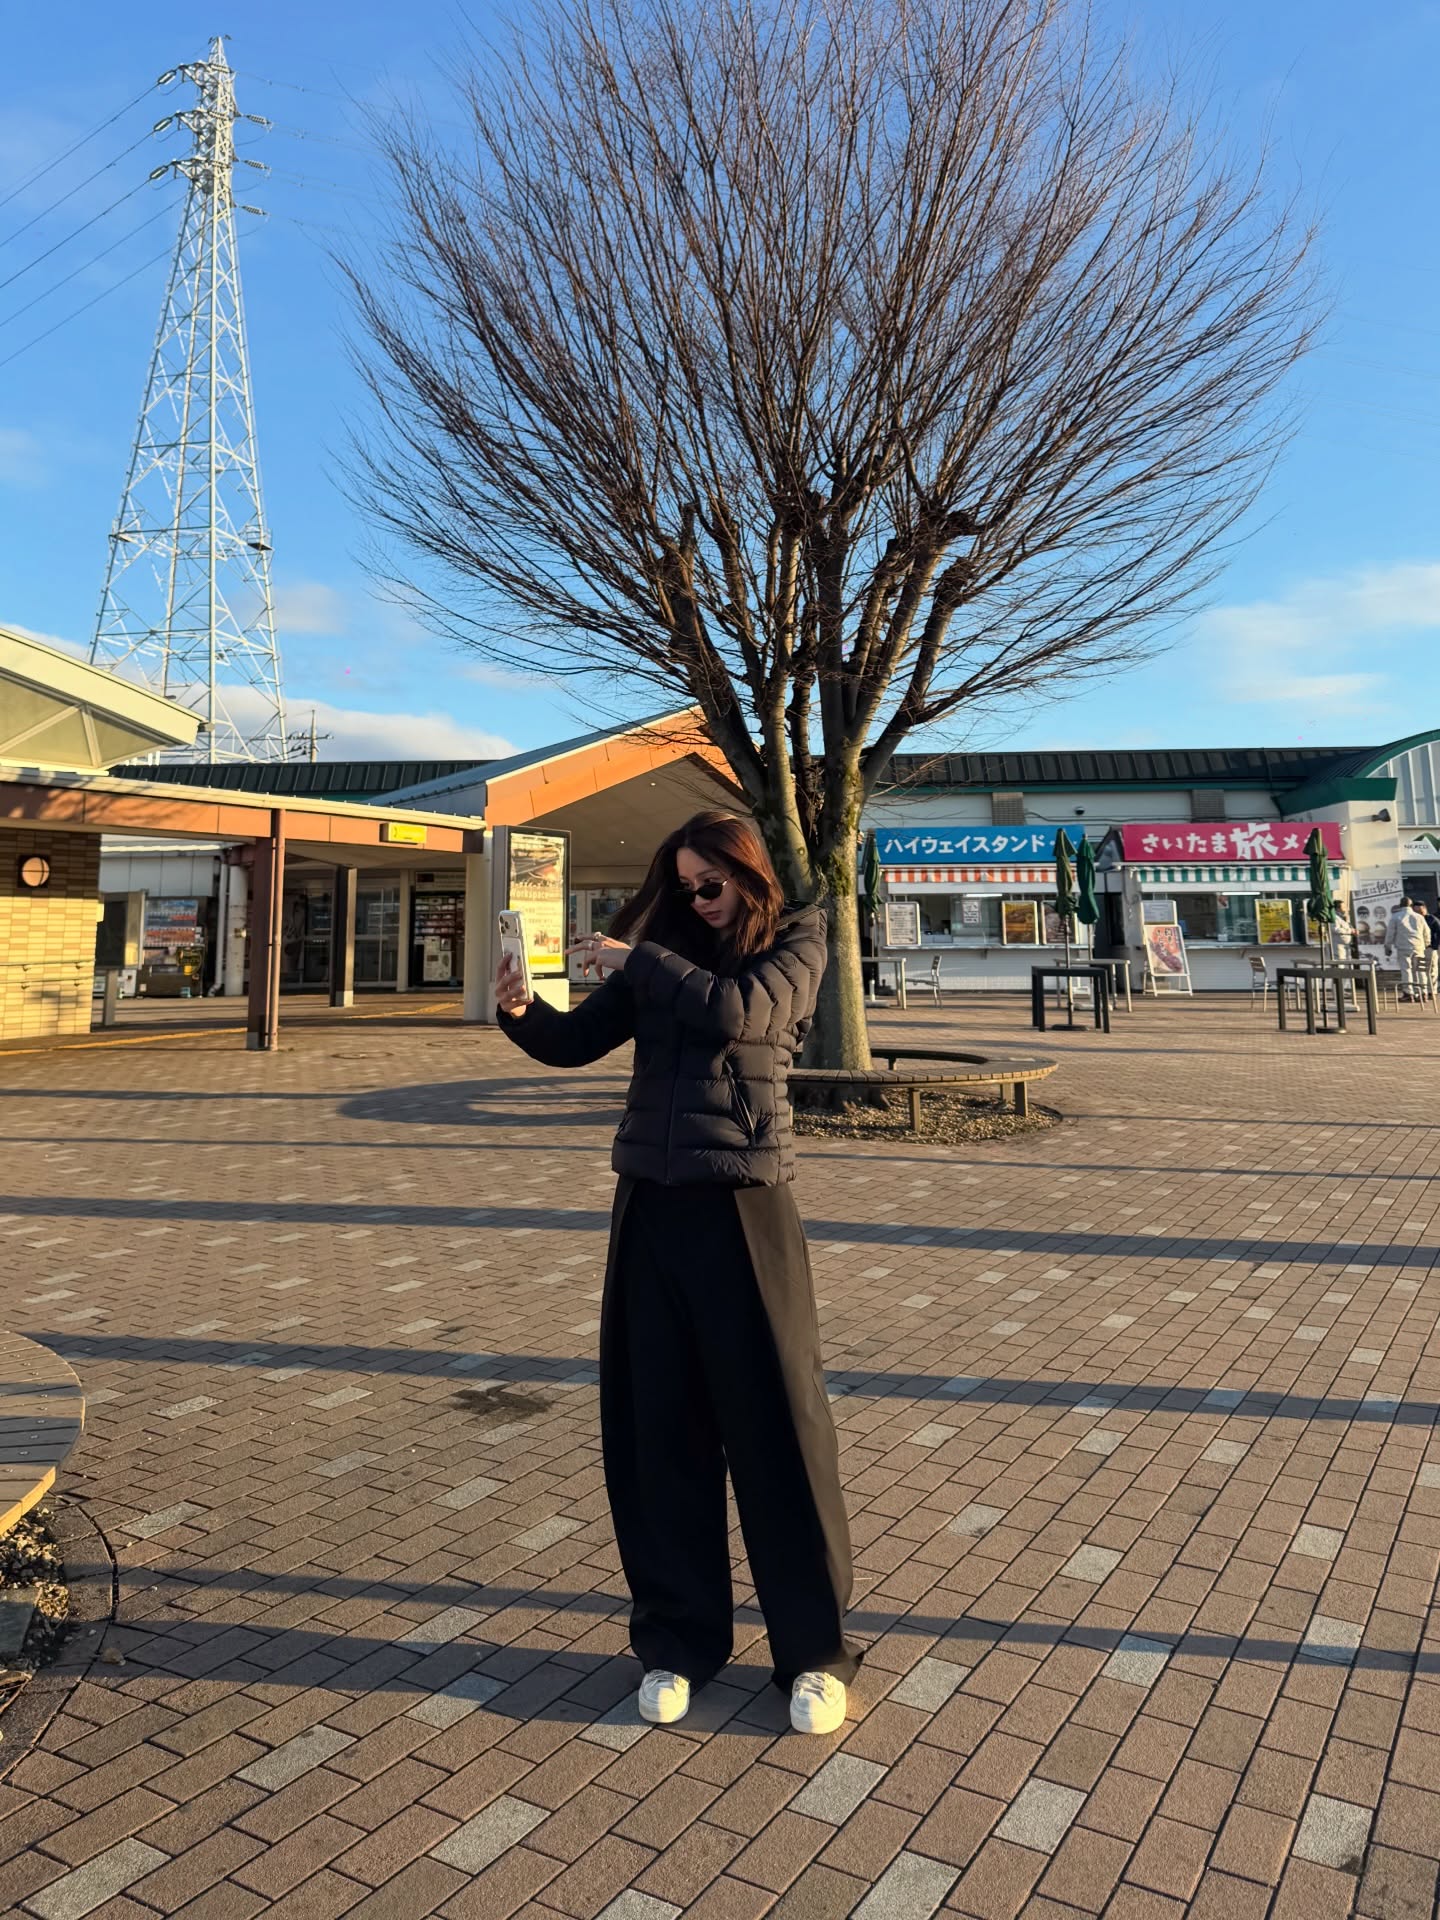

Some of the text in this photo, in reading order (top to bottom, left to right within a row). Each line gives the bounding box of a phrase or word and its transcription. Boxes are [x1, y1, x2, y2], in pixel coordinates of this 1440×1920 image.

[884, 834, 1045, 855] ハイウェイスタンド
[1141, 822, 1309, 860] さいたま旅メ
